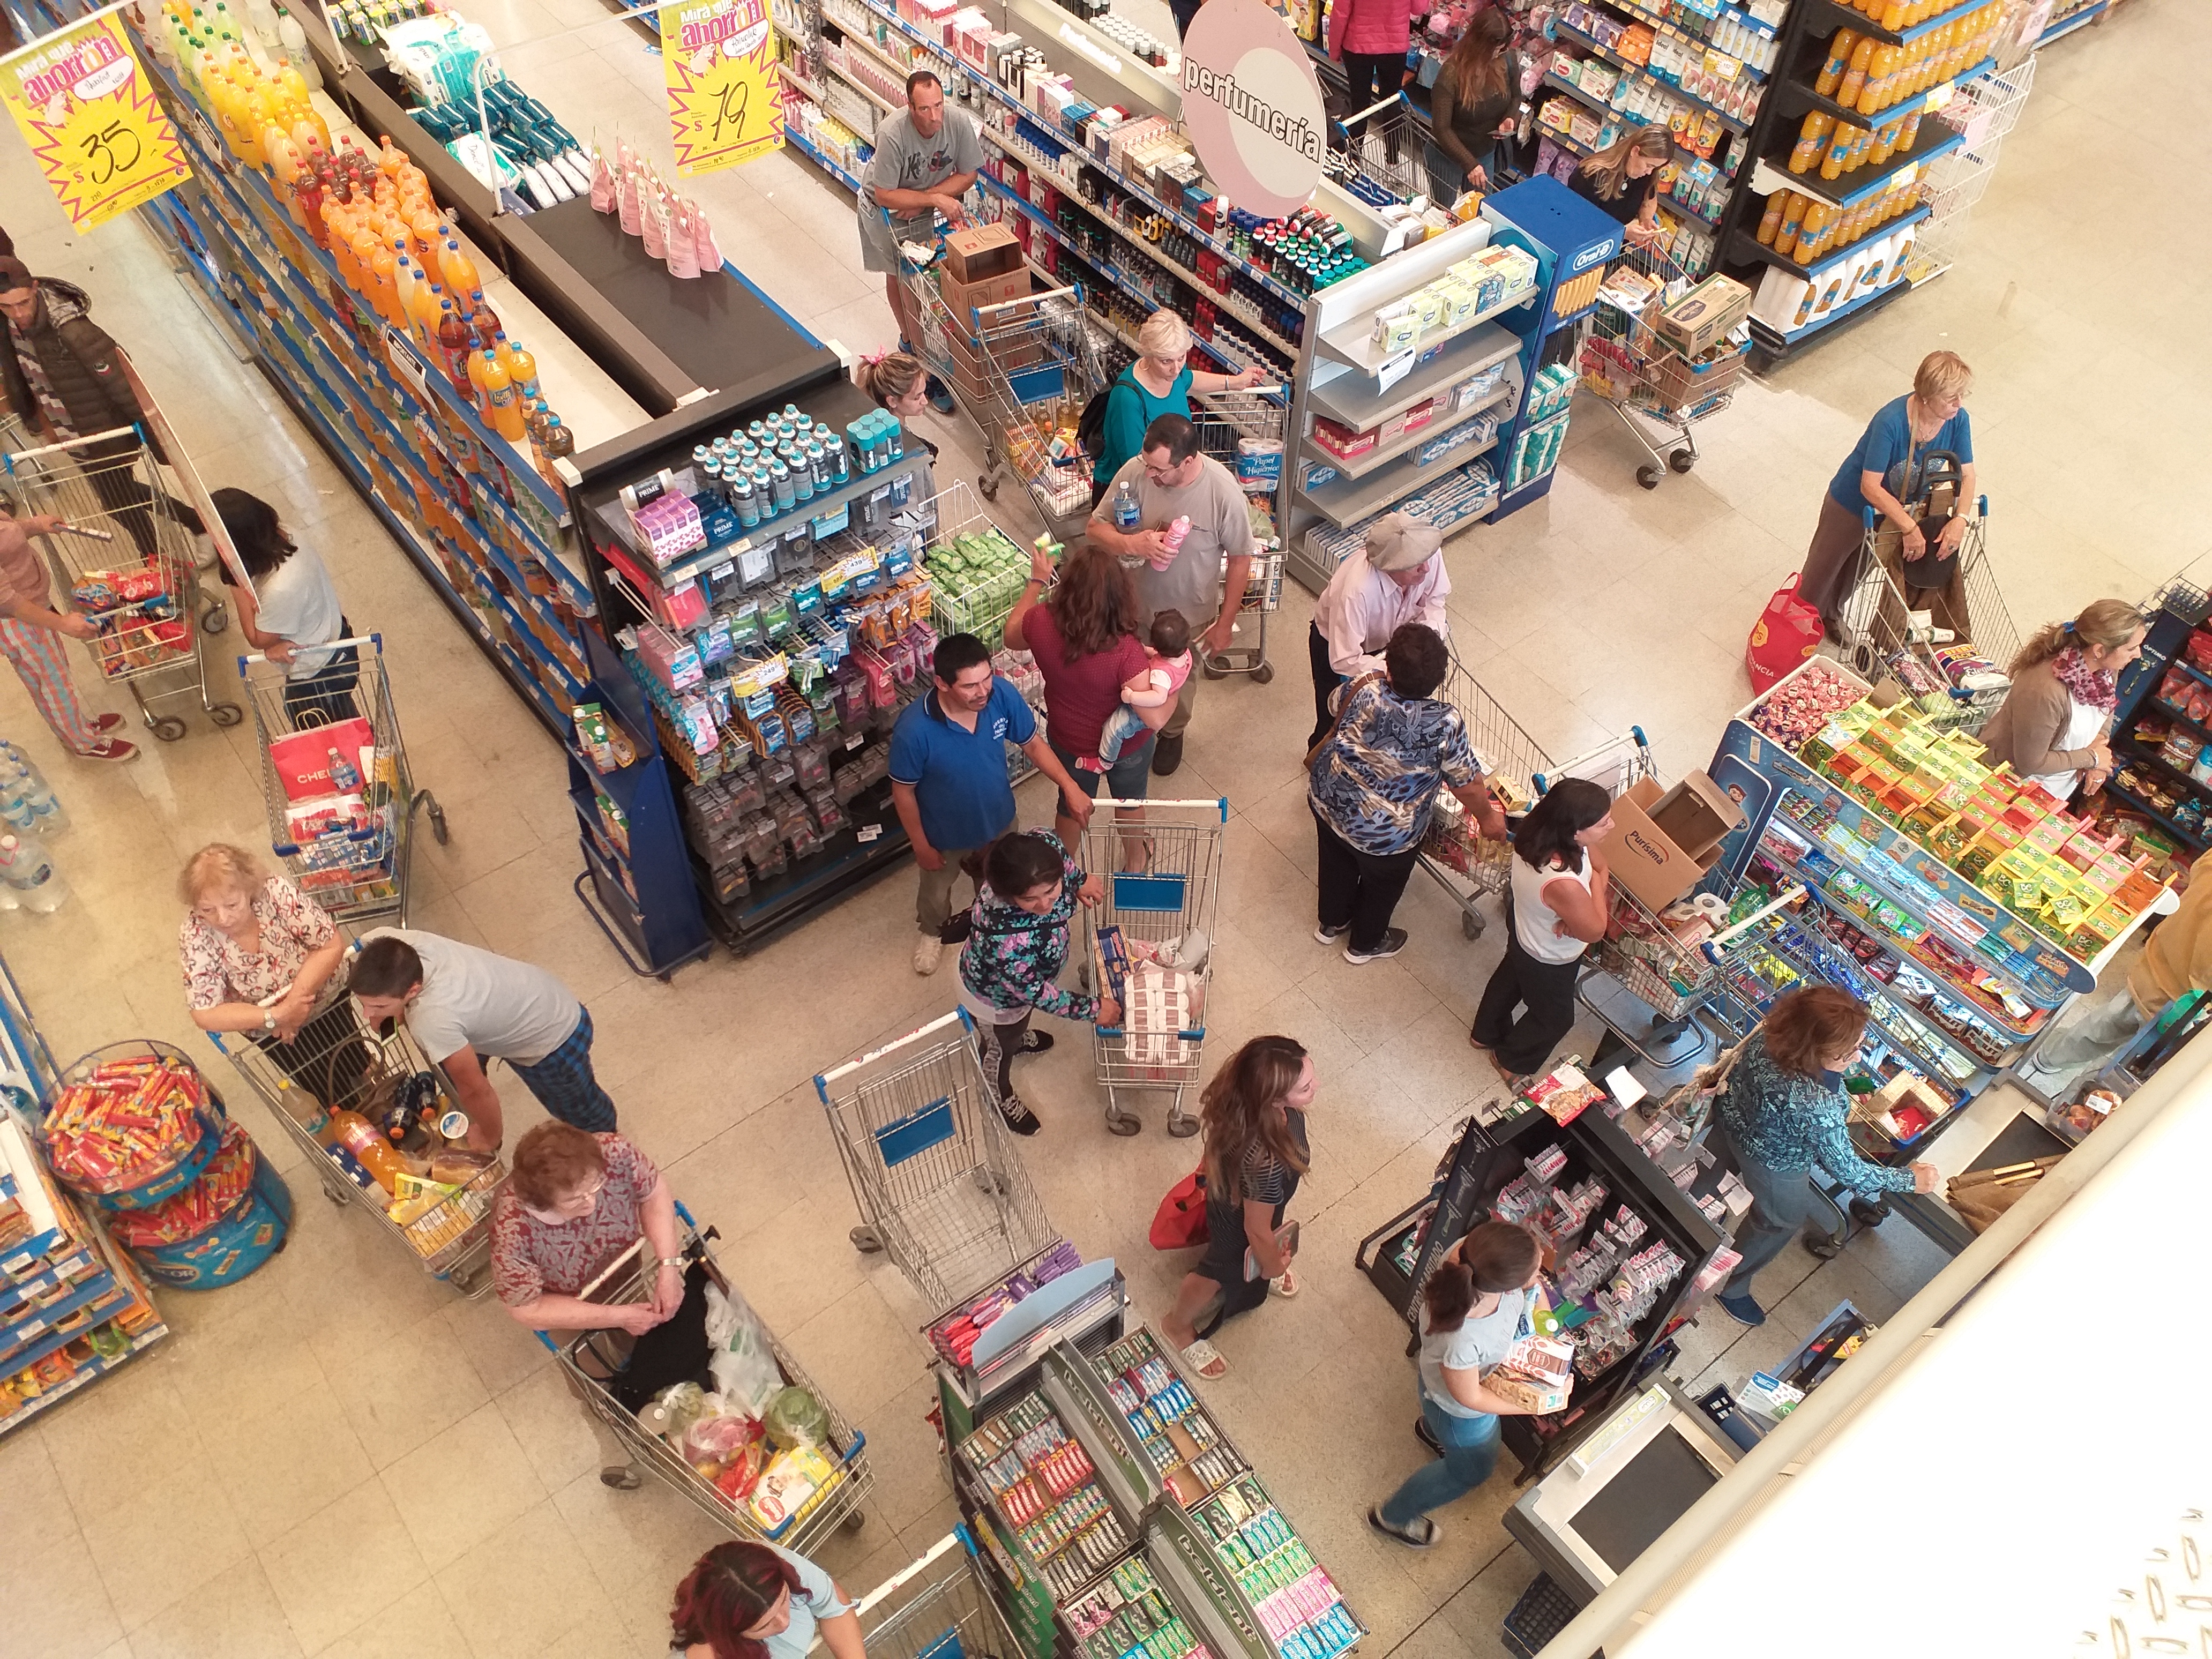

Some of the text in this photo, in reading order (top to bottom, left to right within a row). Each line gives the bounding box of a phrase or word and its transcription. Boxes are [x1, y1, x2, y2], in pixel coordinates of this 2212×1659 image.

[680, 4, 711, 23] Mirá
[694, 81, 748, 142] $ 79
[1184, 56, 1321, 163] perfumería
[79, 118, 140, 184] 35
[1575, 244, 1610, 267] Oral-B
[1700, 286, 1717, 300] Leche
[1676, 302, 1702, 322] Milkaut
[1245, 465, 1280, 476] Higiénico
[1253, 455, 1275, 466] Papel
[638, 483, 660, 498] PRIME
[713, 521, 734, 535] PRIME
[850, 559, 863, 567] 439
[1950, 652, 1971, 661] PACK
[2143, 644, 2166, 661] ÓPTIMO
[763, 667, 775, 676] 249
[1630, 829, 1664, 865] Purísima
[2020, 883, 2032, 891] BC
[2058, 900, 2070, 909] BC
[2015, 928, 2027, 938] BC
[2078, 936, 2093, 947] BC
[2041, 954, 2068, 969] ROCKLETS
[1932, 1005, 1961, 1028] HAMLET
[1517, 1314, 1529, 1337] Suave
[1220, 1548, 1239, 1572] beldent
[1231, 1538, 1252, 1561] beldent
[1014, 1555, 1037, 1583] beldent
[1127, 1566, 1146, 1587] beldent
[1116, 1573, 1134, 1596] beldent
[1178, 1534, 1257, 1642] beldent
[1145, 1598, 1163, 1621] beldent
[1164, 1628, 1183, 1651] beldent
[1174, 1620, 1192, 1644] beldent
[1155, 1634, 1174, 1657] beldent
